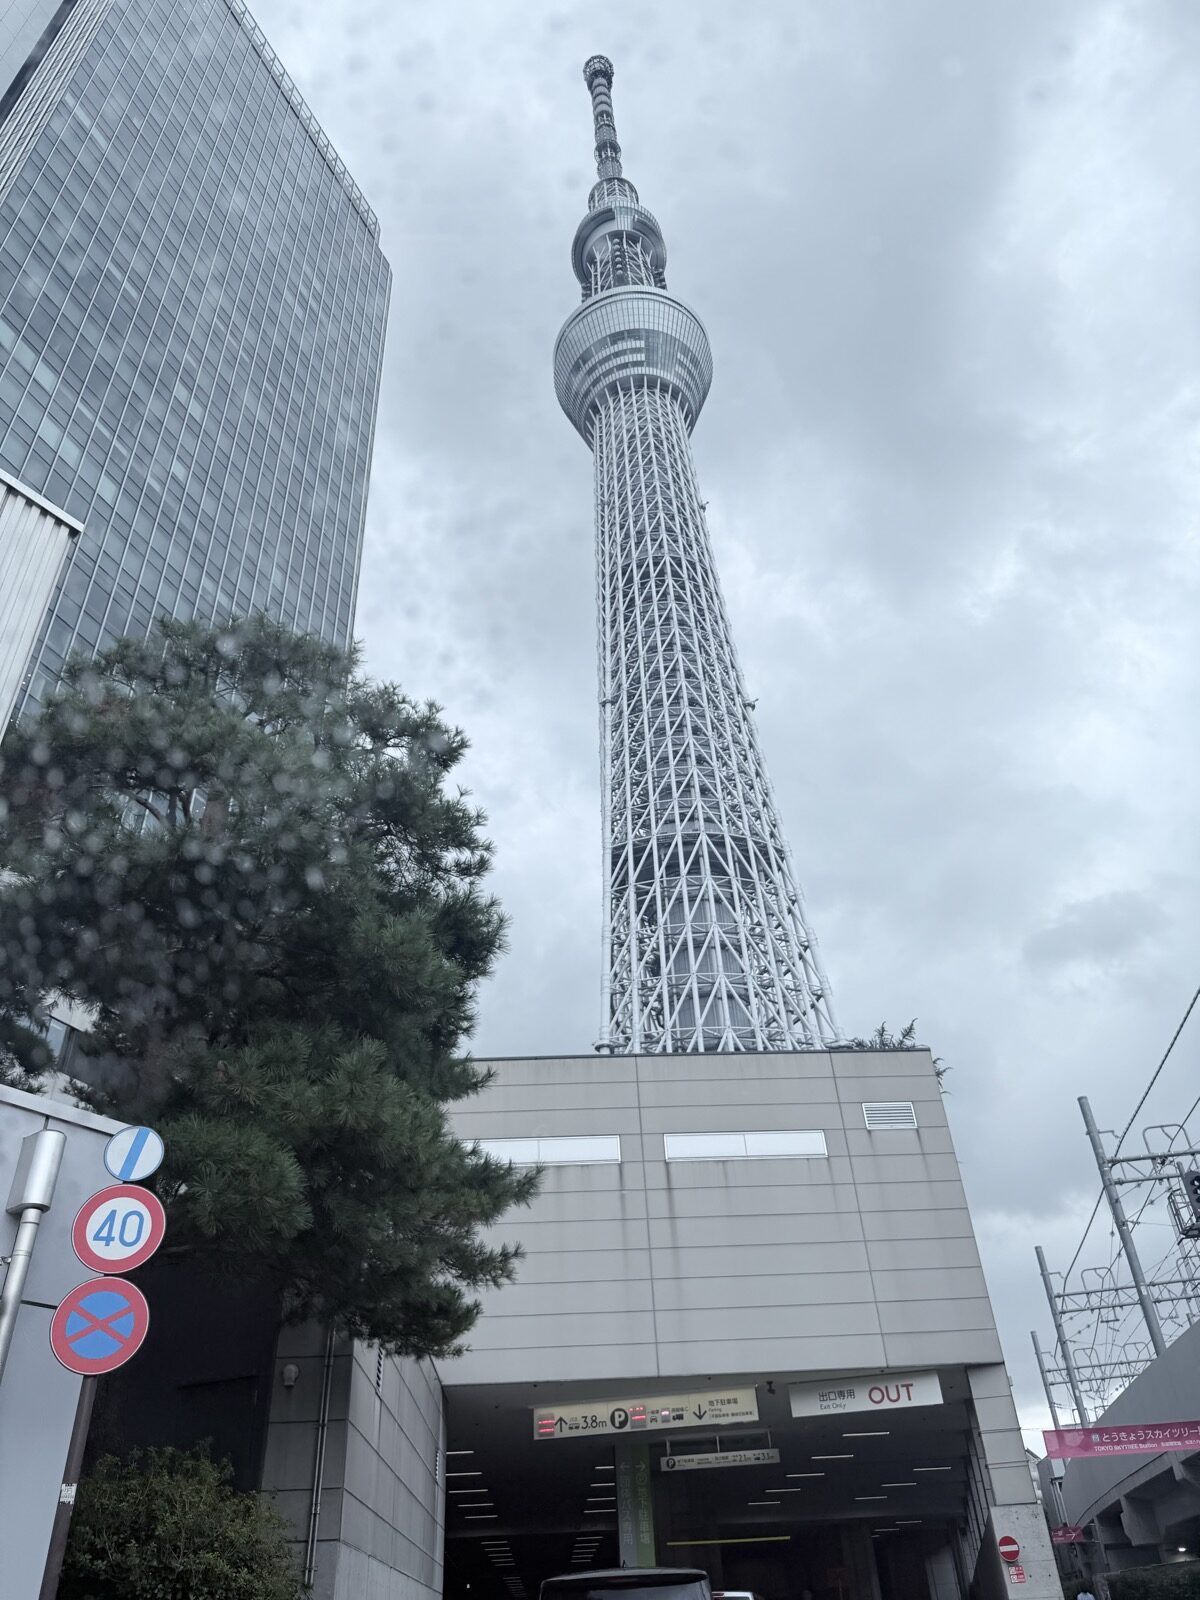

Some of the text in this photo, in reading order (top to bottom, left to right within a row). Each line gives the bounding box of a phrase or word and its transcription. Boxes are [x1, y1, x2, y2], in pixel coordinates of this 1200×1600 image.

[93, 1209, 145, 1247] 40
[818, 1388, 855, 1402] 出口専用
[868, 1383, 913, 1404] OUT
[832, 1402, 846, 1410] Only
[581, 1415, 607, 1430] 3.8m
